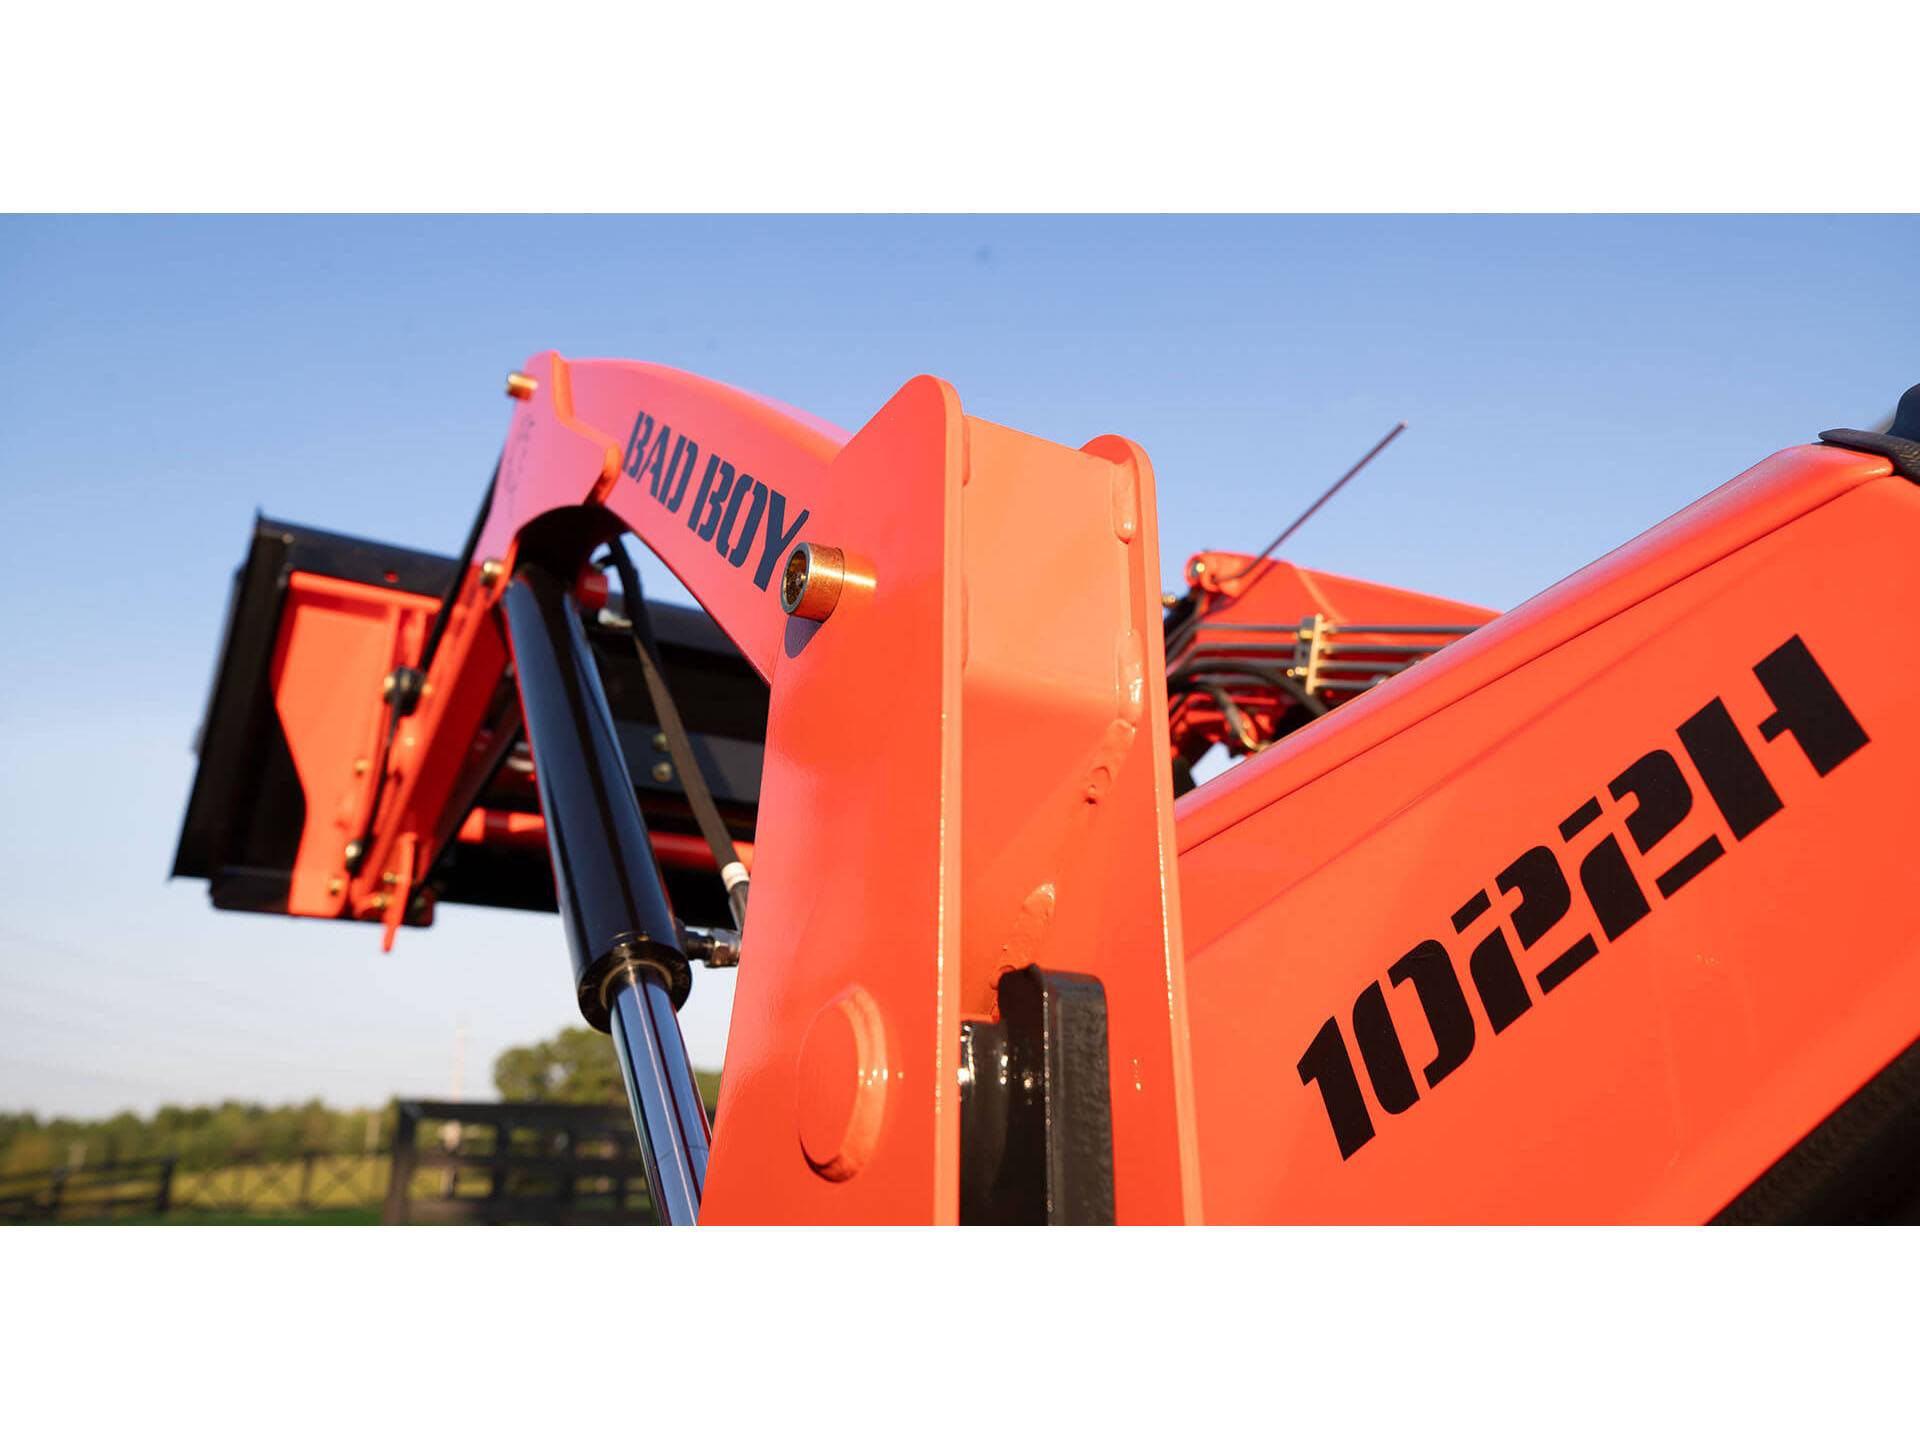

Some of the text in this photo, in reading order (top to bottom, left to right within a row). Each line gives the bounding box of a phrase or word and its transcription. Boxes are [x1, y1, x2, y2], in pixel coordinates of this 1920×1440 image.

[622, 411, 809, 592] BAD BOY
[1296, 634, 1871, 1161] 1022H
